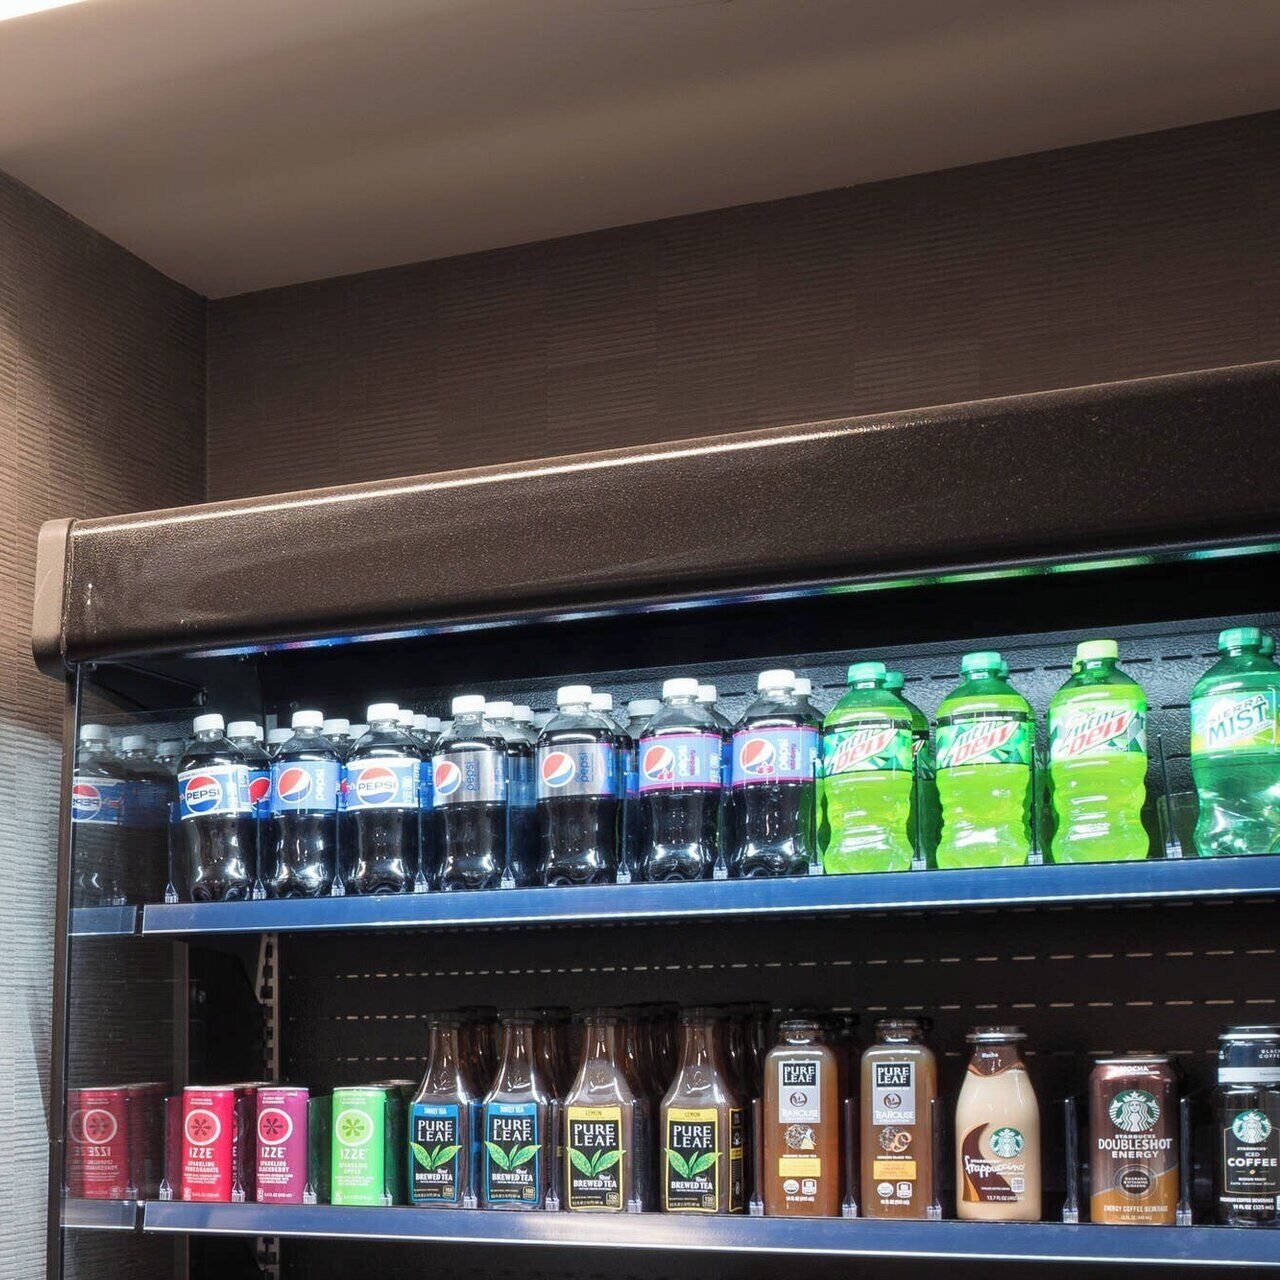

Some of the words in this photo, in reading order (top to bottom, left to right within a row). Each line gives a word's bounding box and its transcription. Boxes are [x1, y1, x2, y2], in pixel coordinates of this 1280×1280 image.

[1209, 695, 1263, 723] SIERRA
[1208, 701, 1268, 746] MIST
[677, 744, 687, 776] pepsi
[777, 738, 789, 771] pepsi
[579, 752, 589, 783] pepsi
[465, 761, 474, 791] pepsi
[316, 769, 325, 801] pepsi
[358, 781, 397, 792] PEPSI
[186, 790, 220, 801] PEPSI
[784, 1066, 815, 1075] PURE
[877, 1067, 910, 1076] PURE
[784, 1074, 812, 1083] LEAF
[877, 1075, 907, 1084] LEAF
[418, 1120, 452, 1131] PURE
[493, 1119, 531, 1130] PURE
[574, 1123, 615, 1135] PURE
[673, 1125, 712, 1137] PURE
[1098, 1138, 1173, 1150] DOUBLESHOT
[189, 1147, 213, 1158] IZZE
[261, 1147, 285, 1158] IZZE
[341, 1149, 366, 1160] IZZE
[1111, 1150, 1159, 1159] ENERGY
[1227, 1158, 1278, 1167] COFFEE
[492, 1173, 520, 1181] BREWED
[671, 1181, 700, 1189] BREWED
[700, 1181, 713, 1189] TEA
